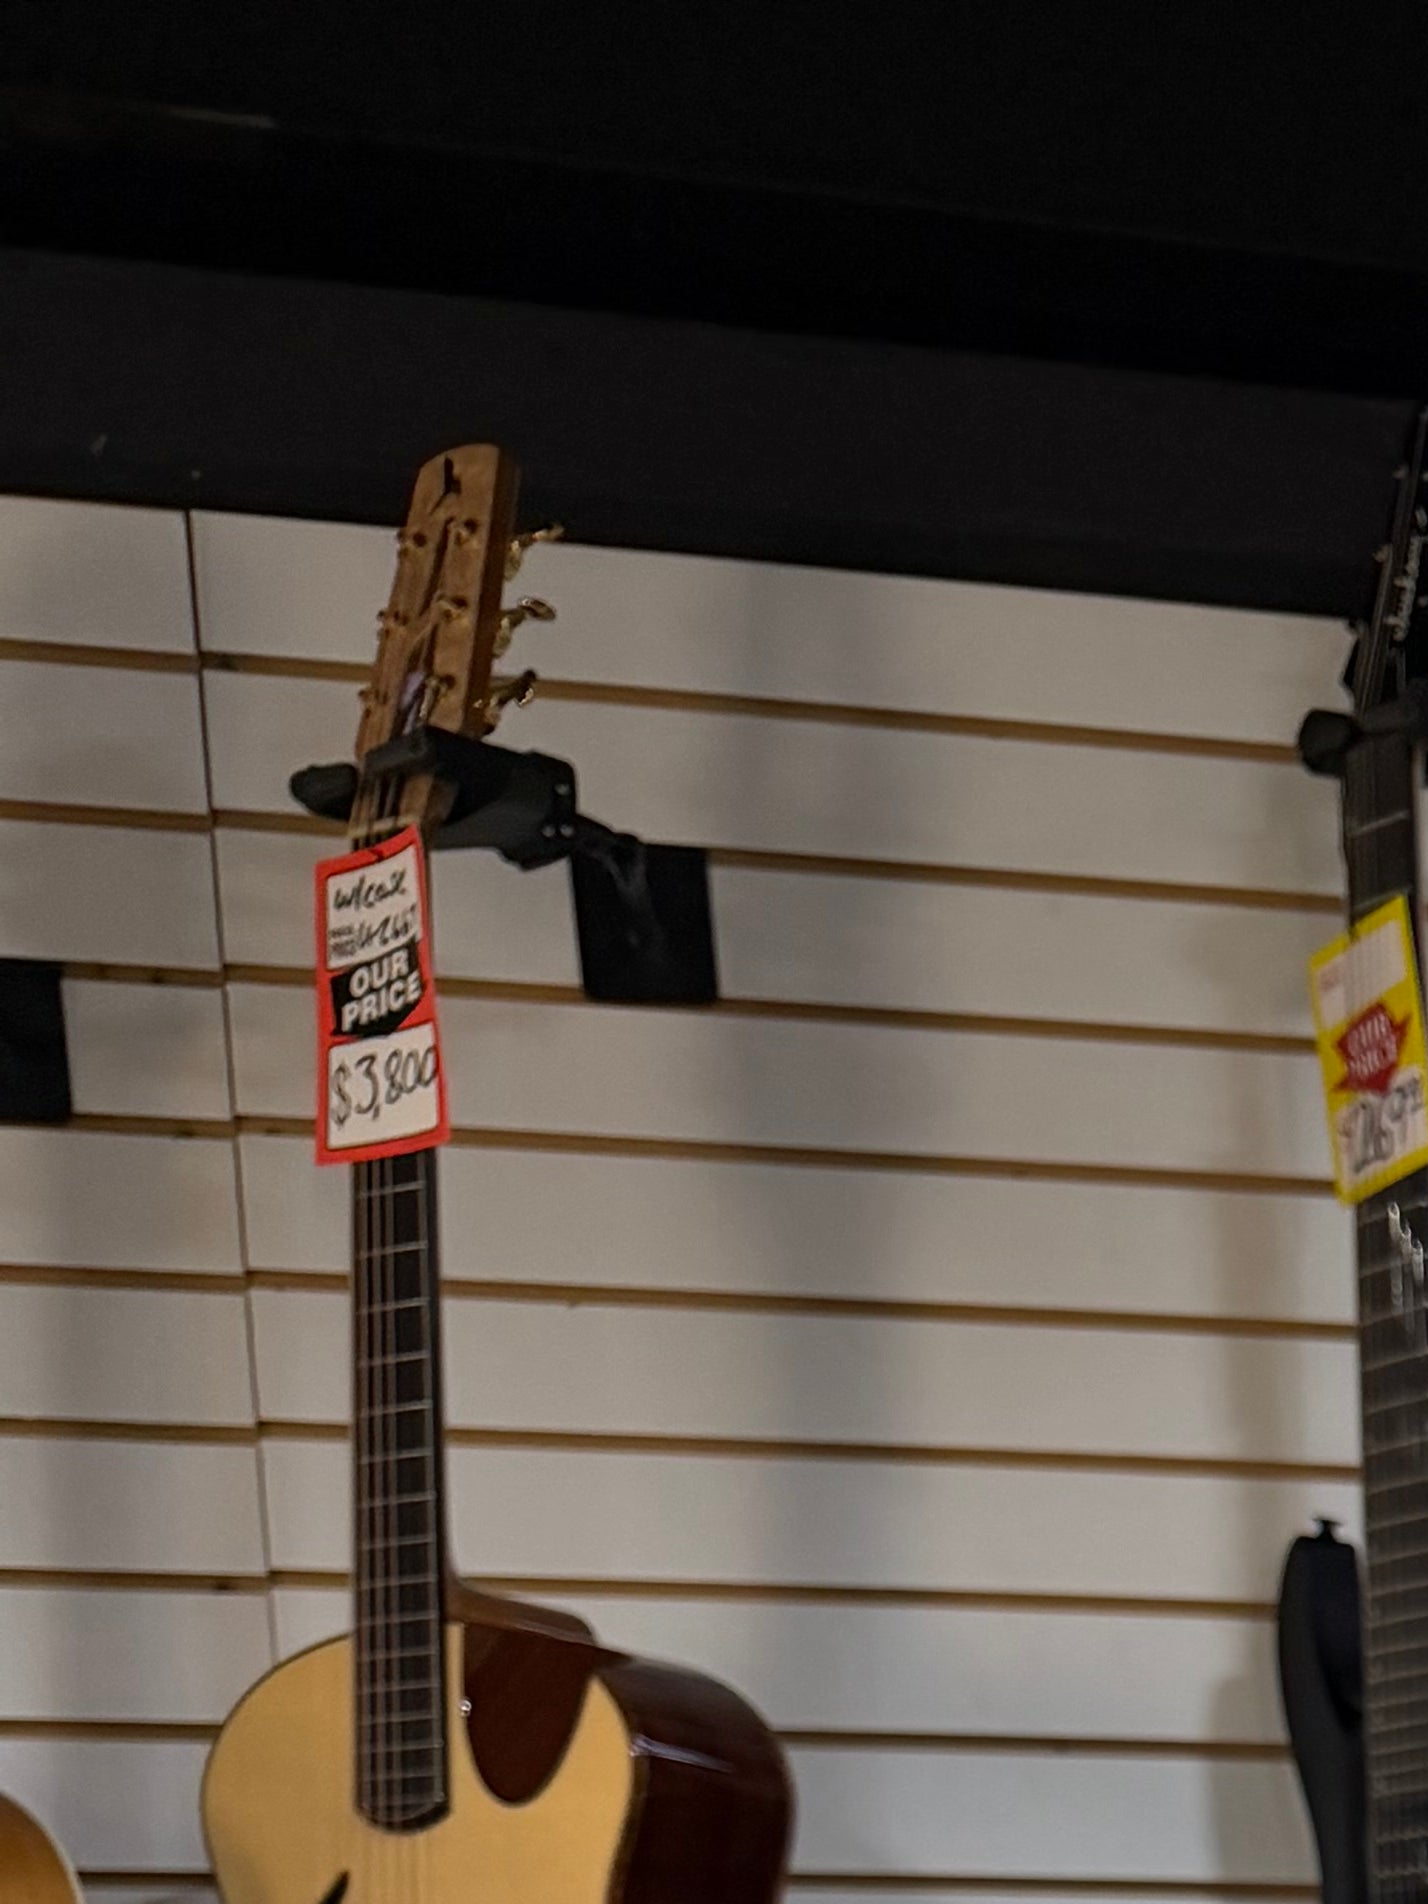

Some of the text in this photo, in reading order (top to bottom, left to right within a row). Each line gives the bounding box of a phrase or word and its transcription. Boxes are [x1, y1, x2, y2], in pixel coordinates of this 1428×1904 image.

[340, 971, 423, 1034] PRICE
[349, 948, 410, 998] OUR
[330, 1045, 438, 1130] $3,800
